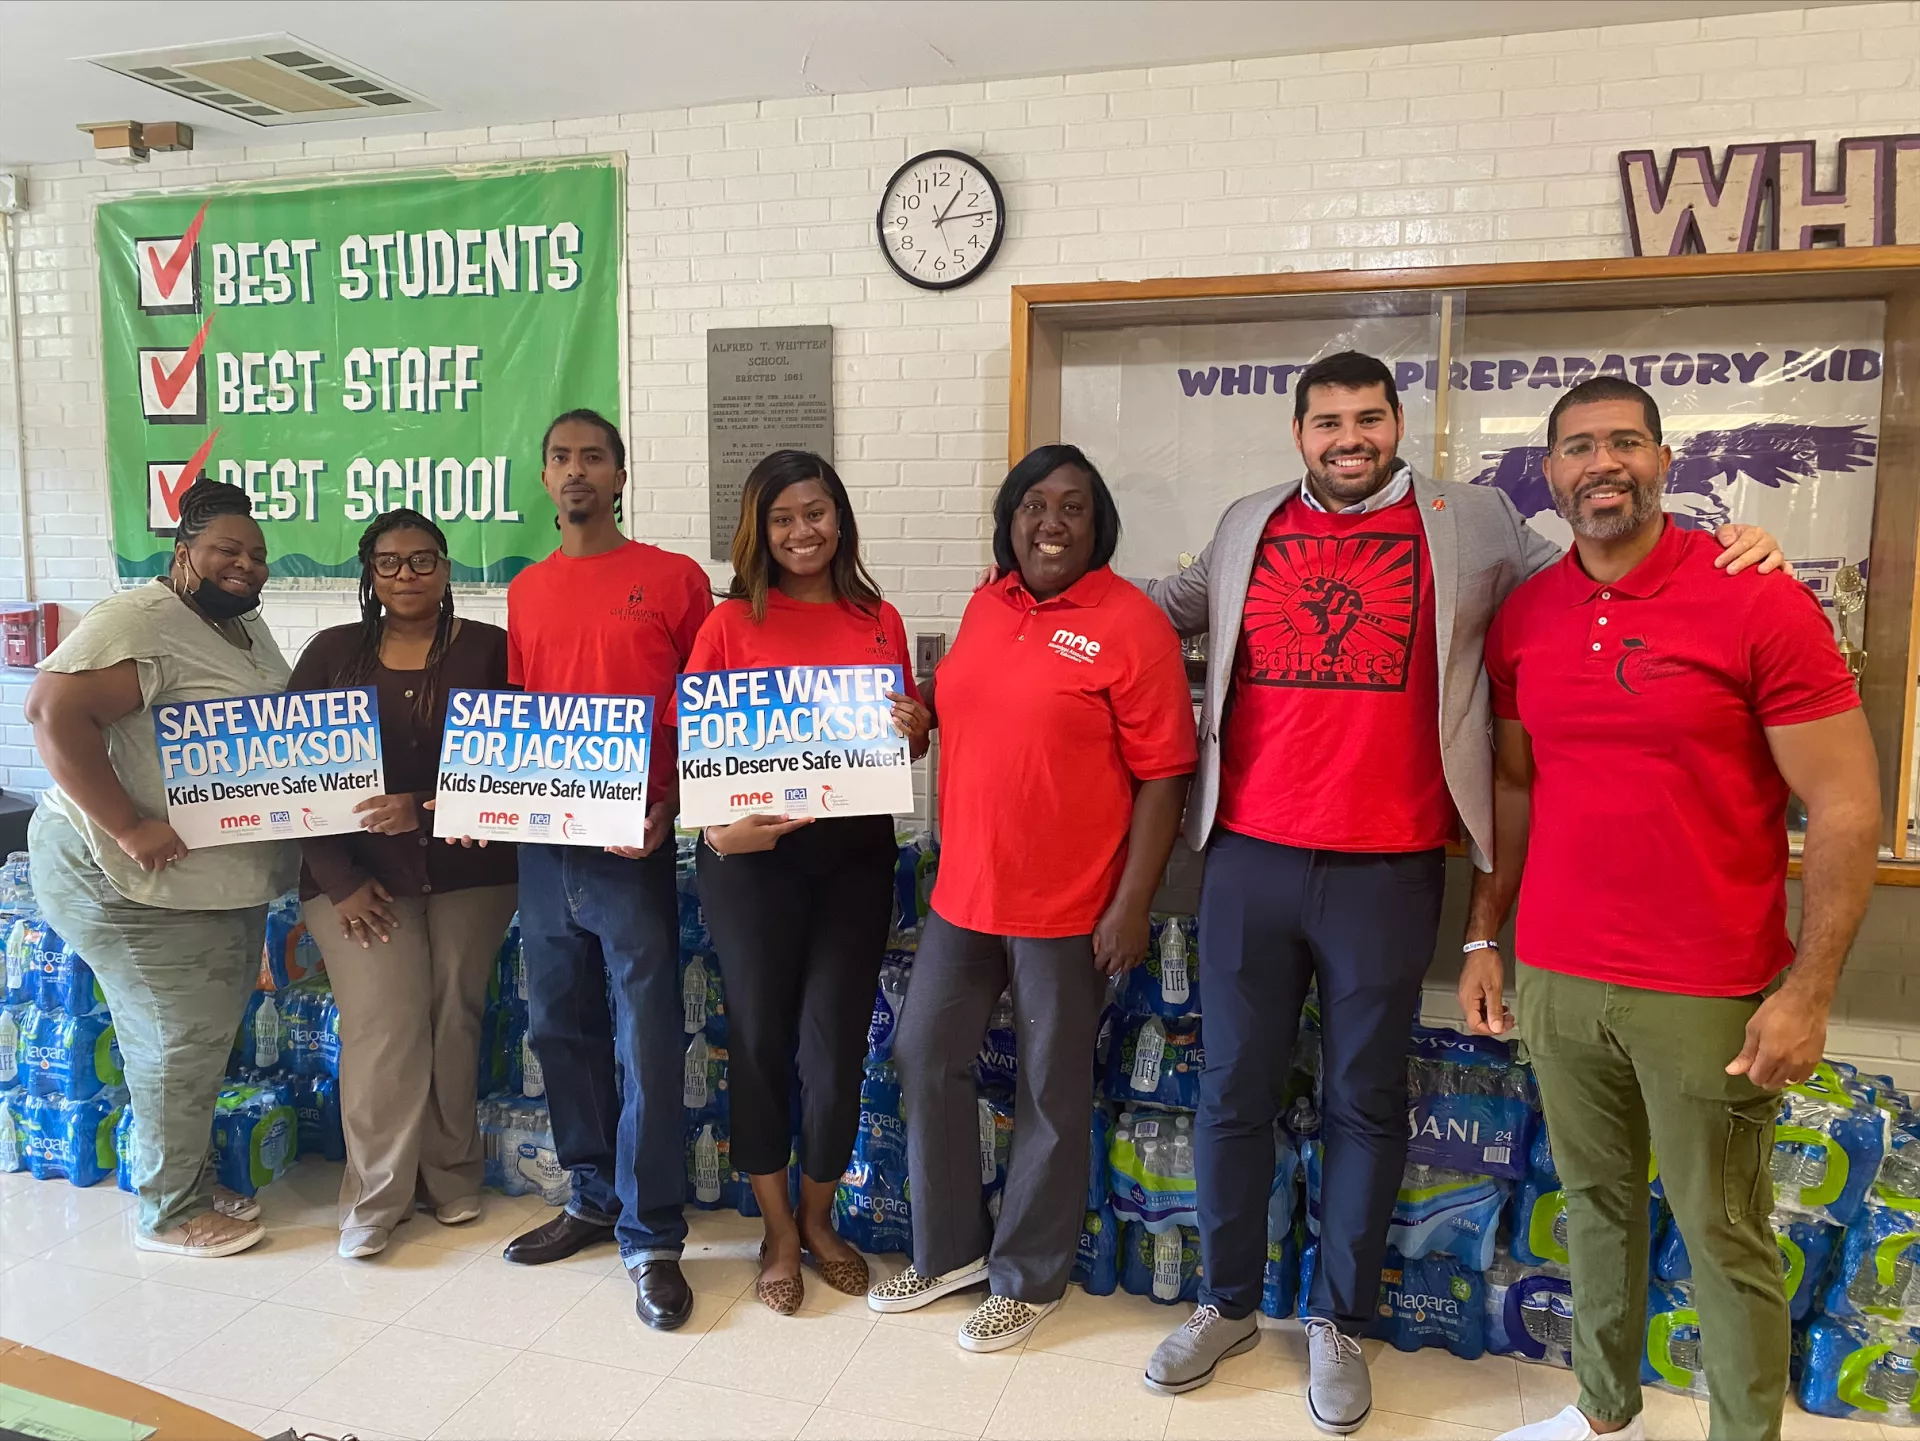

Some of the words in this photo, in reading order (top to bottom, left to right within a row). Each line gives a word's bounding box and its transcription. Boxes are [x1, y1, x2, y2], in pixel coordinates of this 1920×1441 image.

[917, 179, 928, 193] 11
[933, 172, 950, 187] 12
[902, 195, 920, 210] 10
[967, 193, 979, 207] 2
[896, 216, 908, 230] 9
[972, 213, 984, 228] 3
[901, 235, 914, 250] 8
[967, 234, 980, 248] 4
[212, 239, 319, 305] BEST
[339, 221, 582, 301] STUDENTS
[915, 249, 927, 264] 7
[933, 256, 946, 270] 6
[953, 249, 965, 264] 5
[712, 342, 753, 352] ALFRED
[776, 340, 827, 351] WHITTEN
[748, 356, 789, 366] SCHOOL
[216, 349, 324, 415] BEST
[342, 345, 482, 414] STAFF
[735, 373, 776, 382] ERECTED
[1178, 365, 1306, 397] WHIT
[344, 456, 523, 523] SCHOOL
[1251, 645, 1405, 676] Educate!
[682, 671, 770, 711] SAFE
[775, 668, 896, 704] WATER
[158, 700, 248, 741] SAFE
[248, 690, 372, 732] WATER
[450, 692, 533, 728] SAFE
[538, 695, 646, 733] WATER
[681, 712, 749, 751] FOR
[752, 704, 905, 751] JACKSON
[161, 740, 232, 779] FOR
[236, 727, 378, 777] JACKSON
[443, 729, 507, 766] FOR
[508, 733, 646, 773] JACKSON
[682, 759, 721, 780] Kids
[726, 756, 799, 775] Deserve
[802, 751, 841, 770] Safe
[846, 747, 905, 768] Water!
[168, 785, 209, 806] Kids
[212, 780, 280, 801] Deserve
[282, 776, 317, 794] Safe
[319, 769, 379, 791] Water!
[439, 772, 476, 793] Kids
[480, 774, 547, 796] Deserve
[550, 778, 585, 798] Safe
[590, 780, 642, 801] Water!
[786, 788, 806, 800] nea
[271, 811, 289, 822] nea
[531, 813, 550, 824] nea
[1164, 970, 1186, 991] LIFE
[291, 1029, 336, 1044] niagara
[1410, 1037, 1474, 1053] DASA
[979, 1051, 1018, 1069] WAT
[1135, 1059, 1157, 1082] LIFE
[1407, 1106, 1480, 1144] SANI
[1495, 1131, 1512, 1142] 24
[854, 1193, 908, 1216] niagara
[1452, 1217, 1462, 1225] 24
[1464, 1220, 1480, 1233] PACK
[1156, 1244, 1180, 1260] VIDA
[1163, 1262, 1179, 1274] ESTA
[1155, 1272, 1179, 1286] BOTELLA
[1454, 1282, 1467, 1291] 24
[1388, 1291, 1459, 1314] niagara
